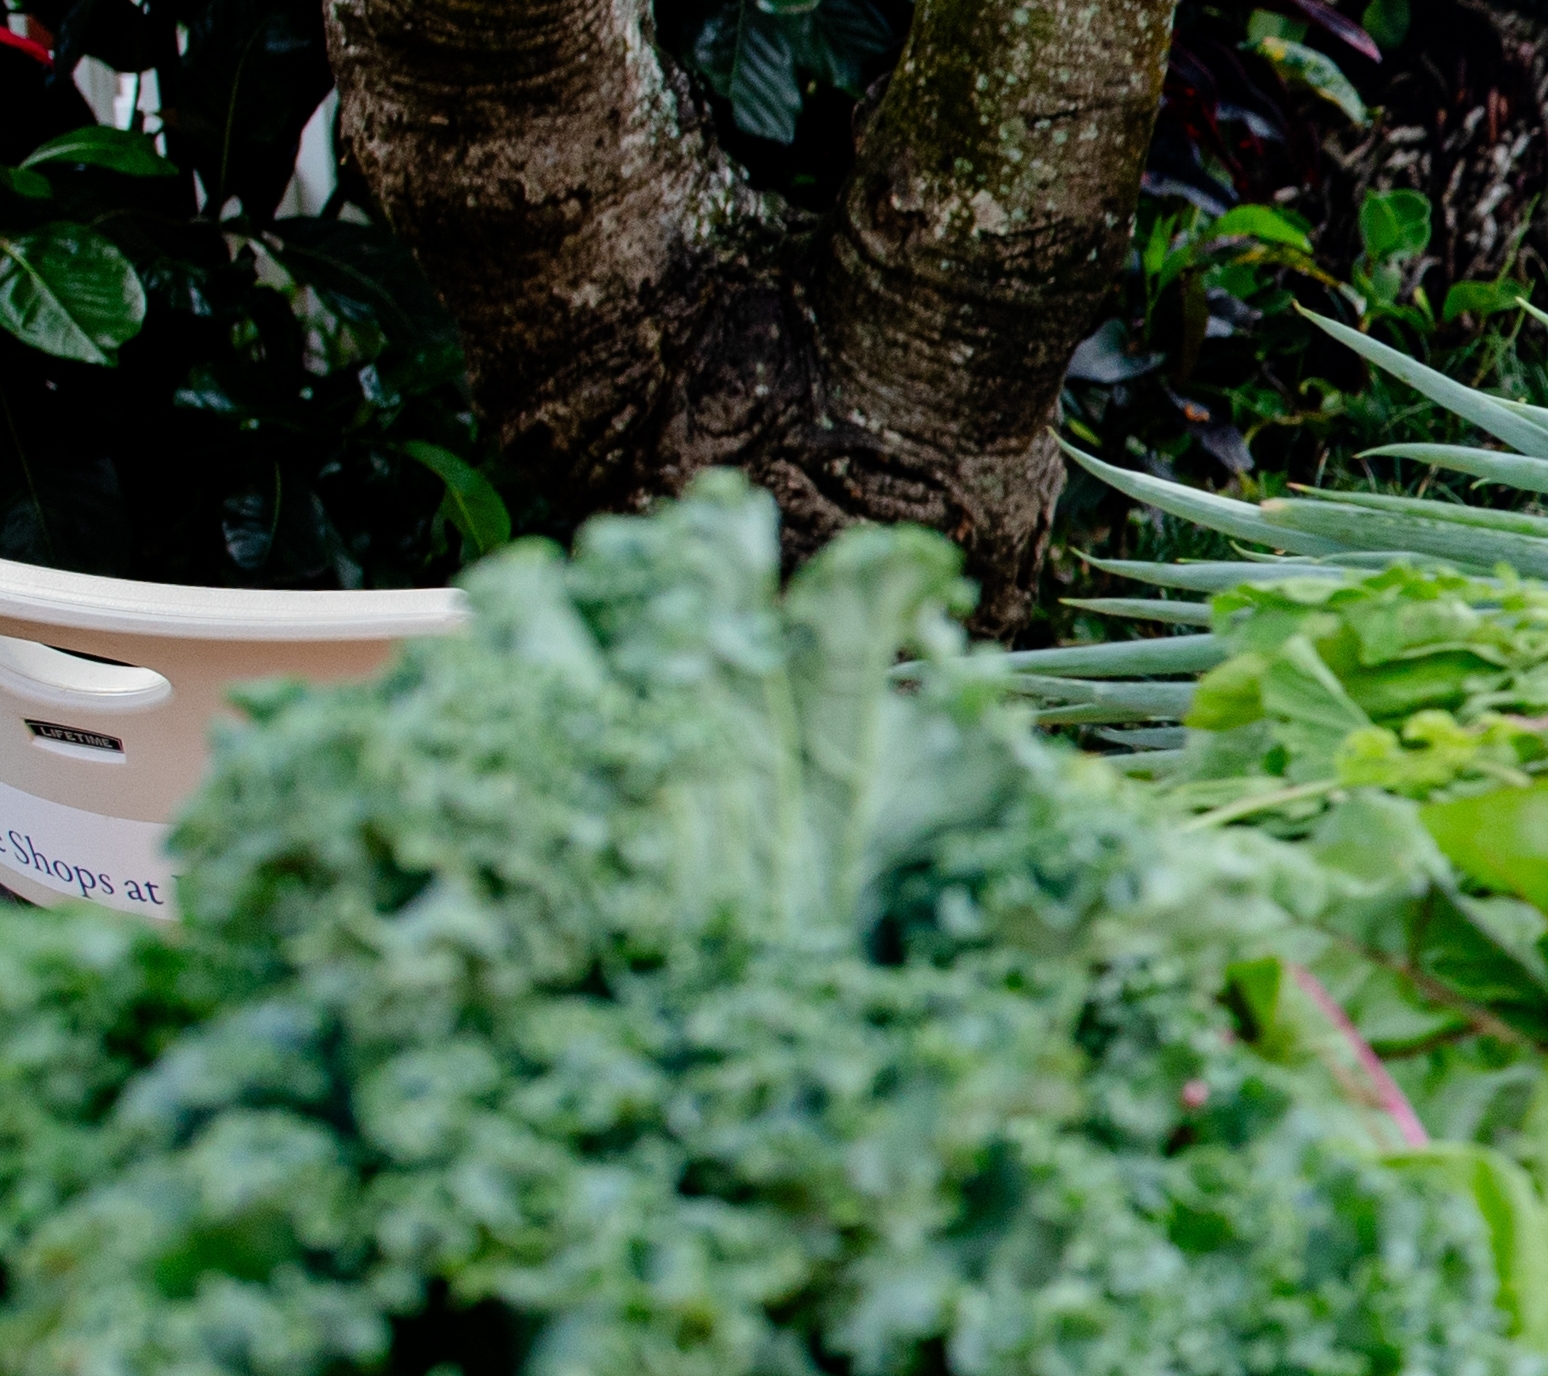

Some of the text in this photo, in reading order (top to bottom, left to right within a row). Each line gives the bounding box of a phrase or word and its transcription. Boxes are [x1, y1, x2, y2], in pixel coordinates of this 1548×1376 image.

[39, 726, 114, 749] LIFETIME
[8, 830, 164, 905] Shops at
